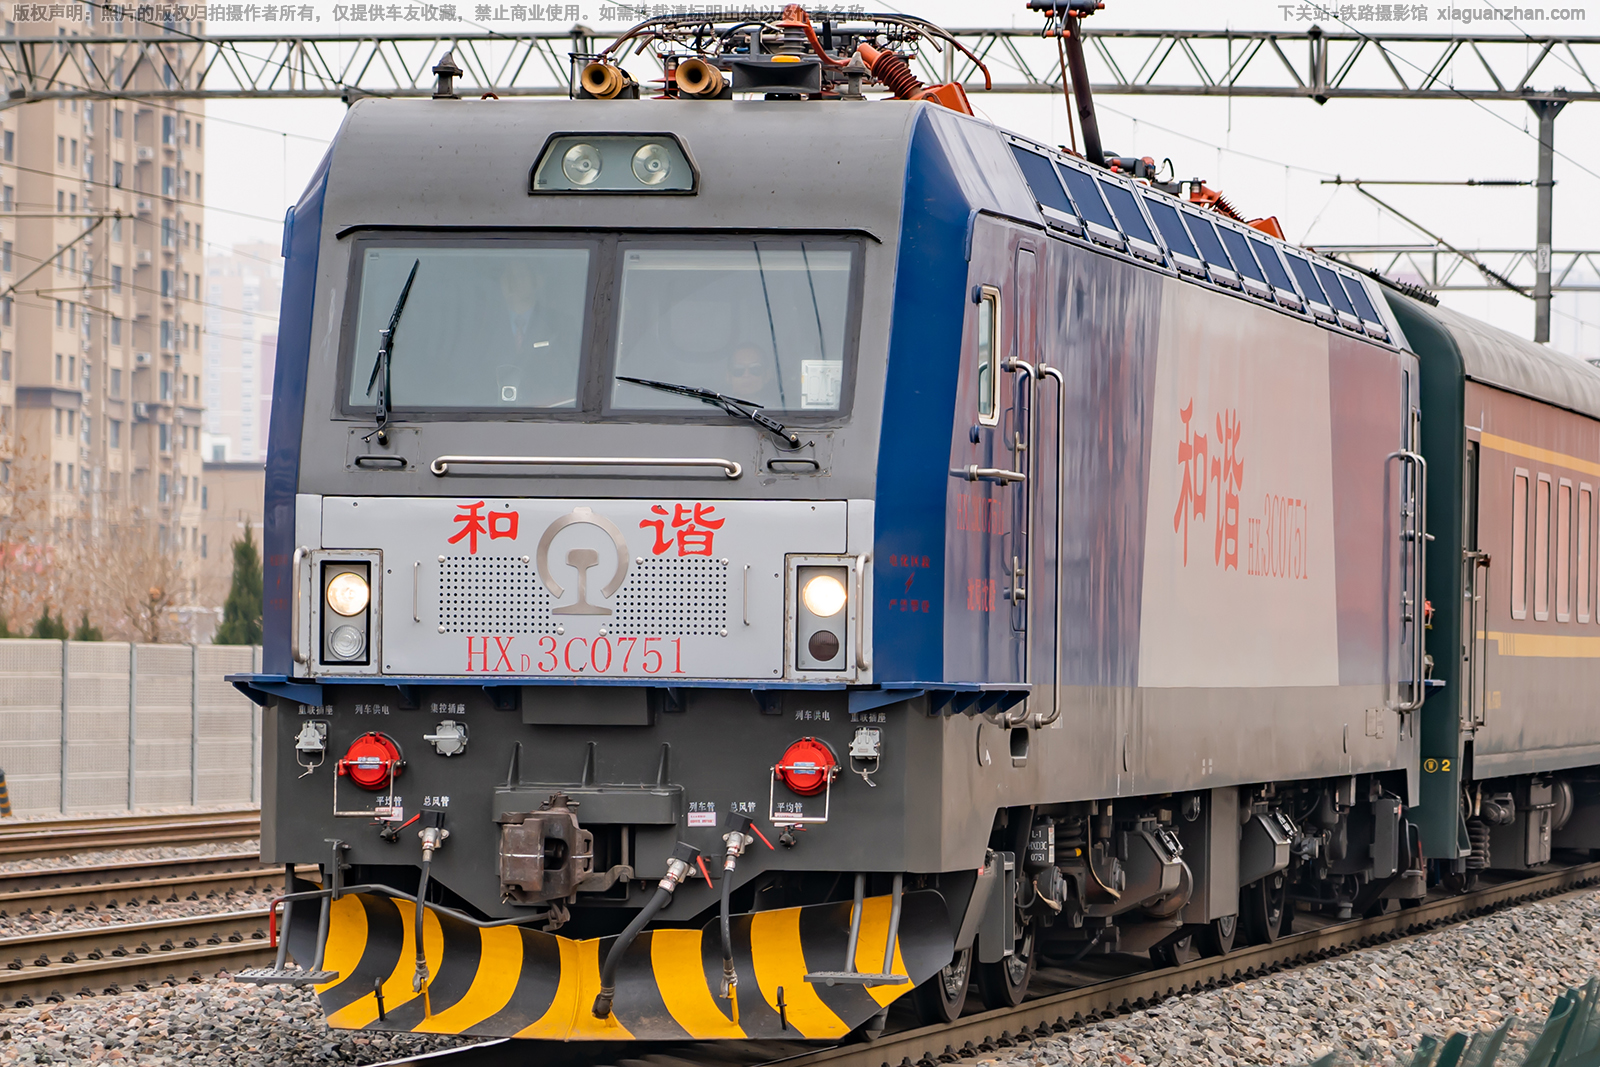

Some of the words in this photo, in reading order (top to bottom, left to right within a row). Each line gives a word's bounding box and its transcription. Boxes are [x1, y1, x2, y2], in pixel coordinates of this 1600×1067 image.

[1173, 396, 1245, 572] 和谐
[447, 500, 520, 555] 和
[638, 502, 726, 557] 谐
[464, 636, 687, 674] HXD3C0751
[354, 704, 391, 715] 列车供电
[430, 703, 466, 715] 集控插座
[794, 710, 831, 721] 列车供电
[1441, 758, 1451, 772] 2
[423, 795, 450, 807] 总风管
[688, 801, 716, 812] 列车管
[776, 802, 803, 813] 平均管
